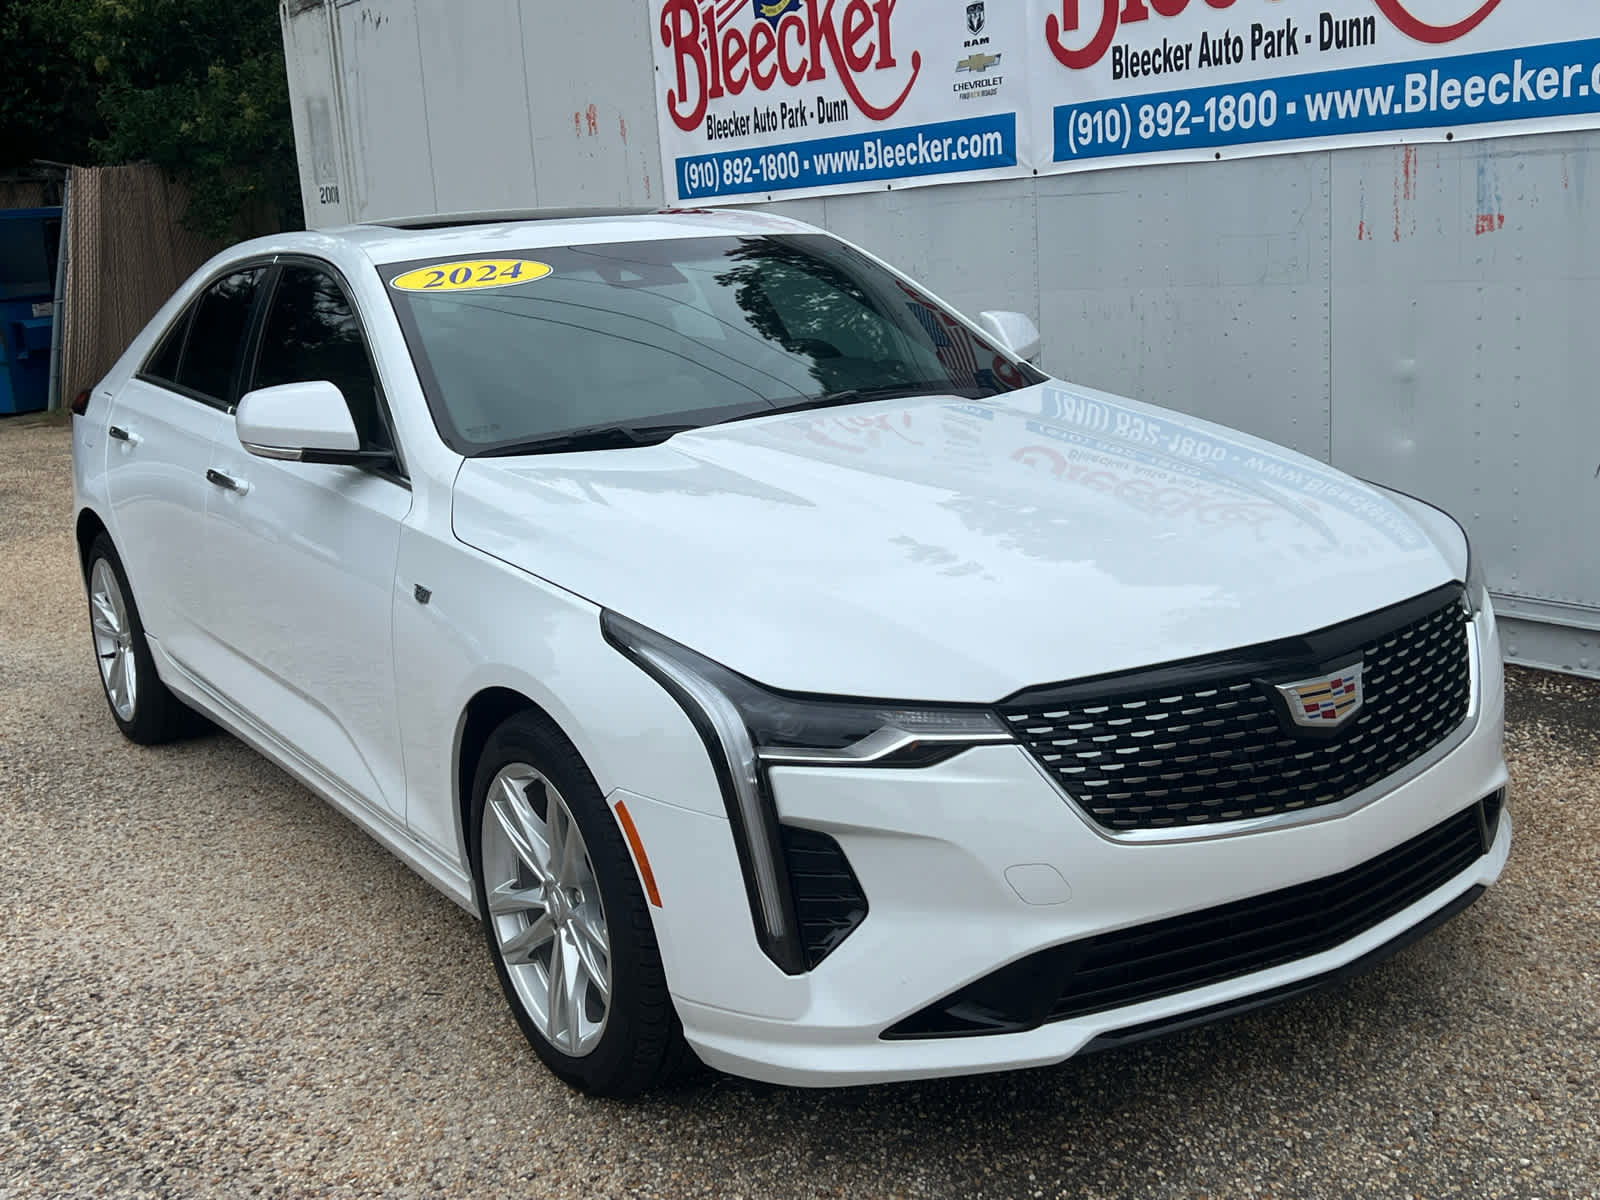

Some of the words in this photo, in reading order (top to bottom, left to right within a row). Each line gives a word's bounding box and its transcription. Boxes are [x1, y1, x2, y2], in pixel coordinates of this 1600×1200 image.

[963, 37, 990, 48] RAM
[1112, 37, 1193, 80] Bleecker
[1198, 28, 1243, 68] Auto
[1251, 18, 1299, 60] Park
[1319, 12, 1376, 51] Dunn
[953, 76, 1003, 91] CHEVROLET
[706, 111, 751, 140] Bleecker
[753, 107, 778, 134] Auto
[780, 102, 808, 130] Park
[817, 97, 849, 124] Dunn
[1068, 103, 1131, 154] (910)
[1138, 89, 1277, 140] 892-1800
[684, 158, 720, 195] (910)
[722, 150, 800, 185] 892-1800
[812, 130, 1003, 176] www.Bleecker.com
[423, 261, 522, 289] 2024
